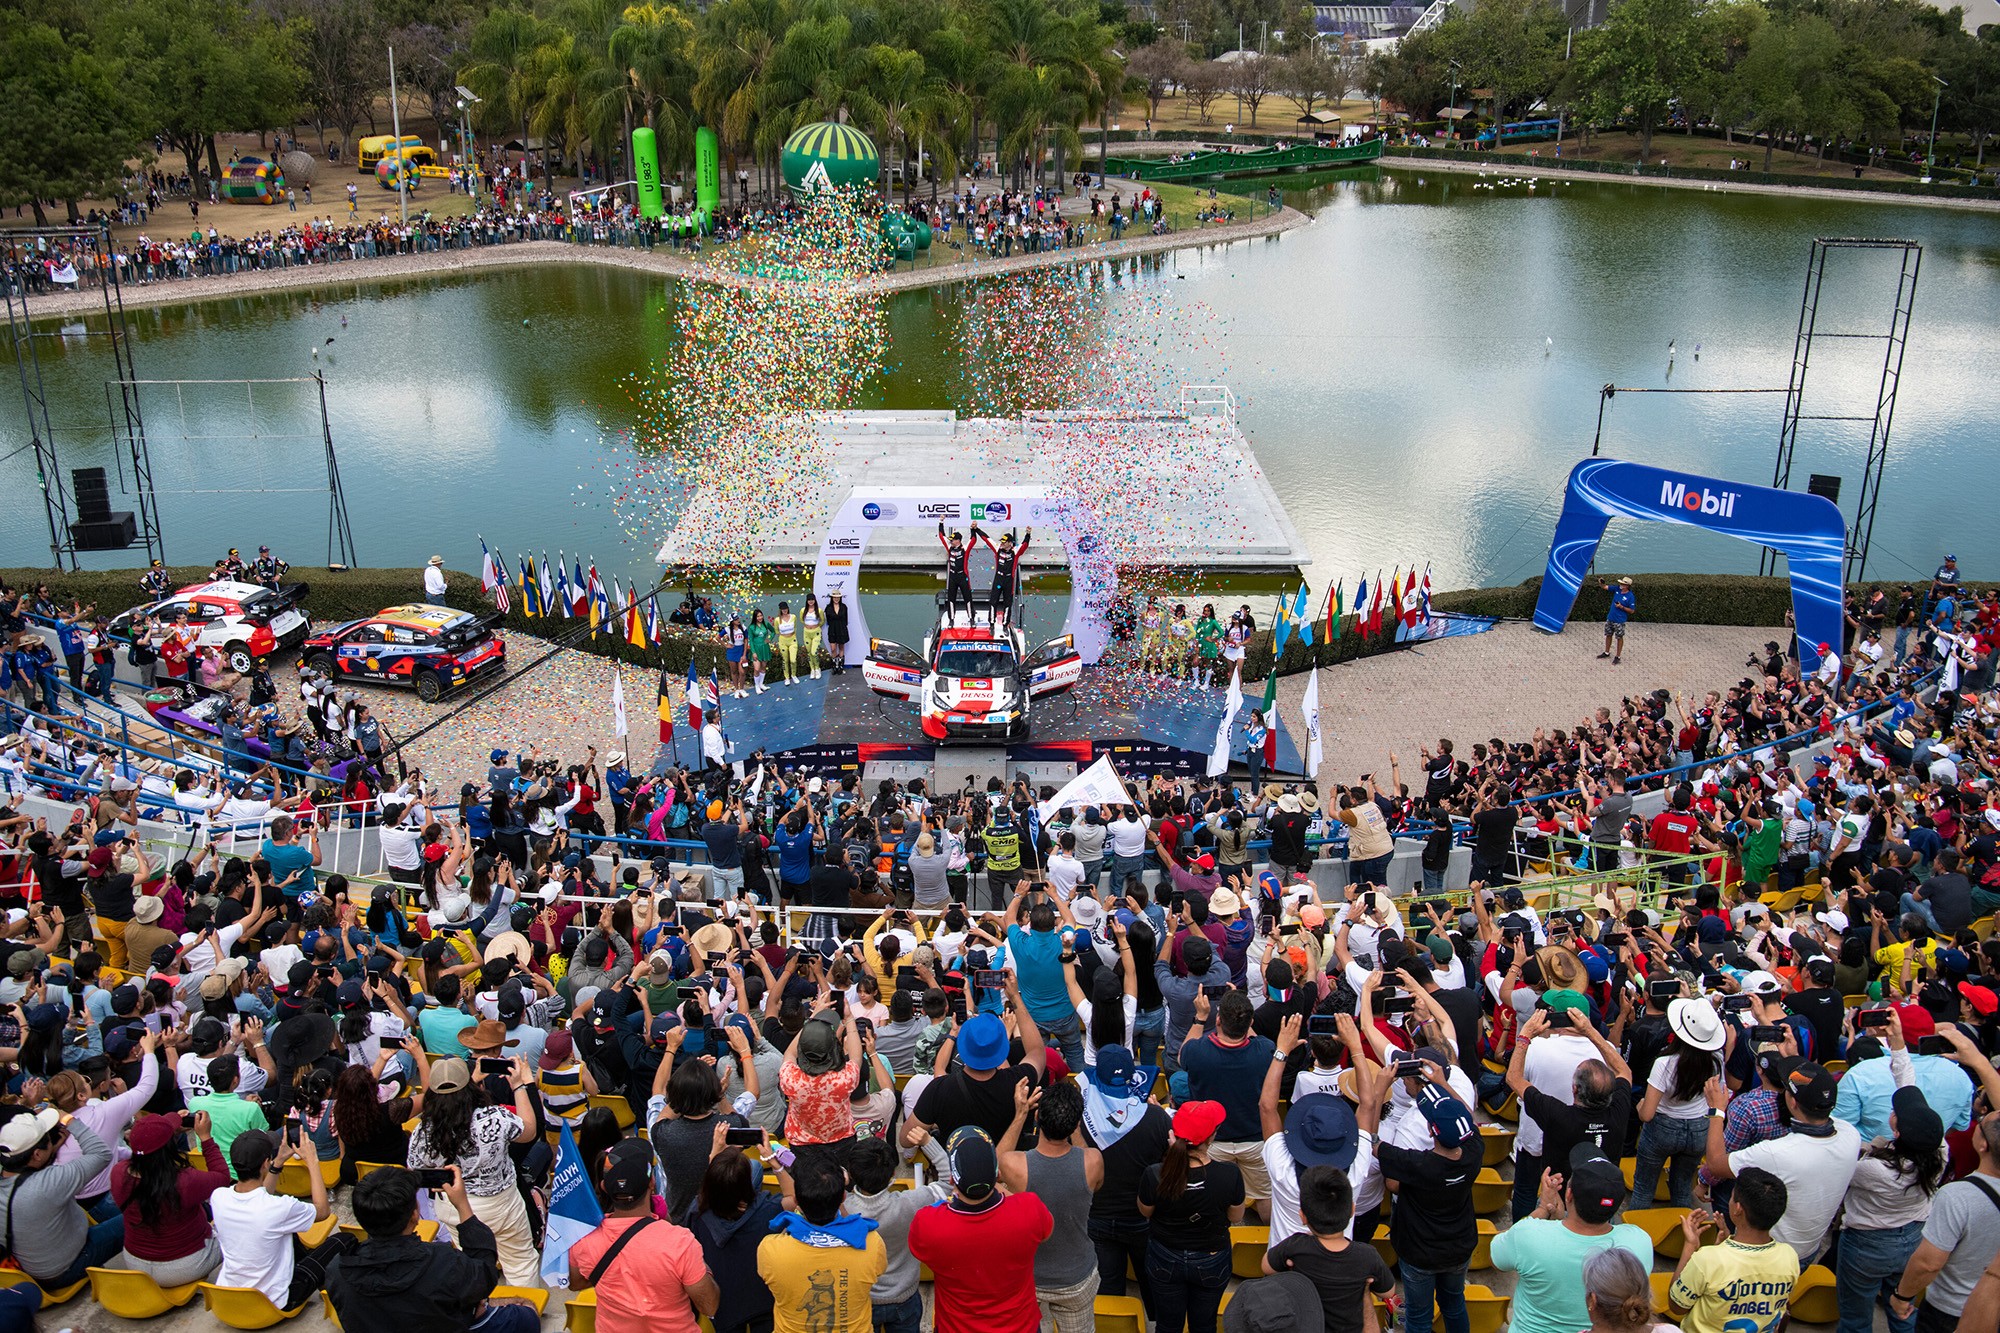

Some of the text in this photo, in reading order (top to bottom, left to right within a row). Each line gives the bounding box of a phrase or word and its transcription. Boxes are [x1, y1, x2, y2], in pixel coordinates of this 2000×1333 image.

[918, 503, 960, 513] WRC
[971, 507, 984, 517] 19
[188, 601, 197, 614] 33
[865, 671, 894, 683] DENSO
[1055, 667, 1081, 680] DENSO
